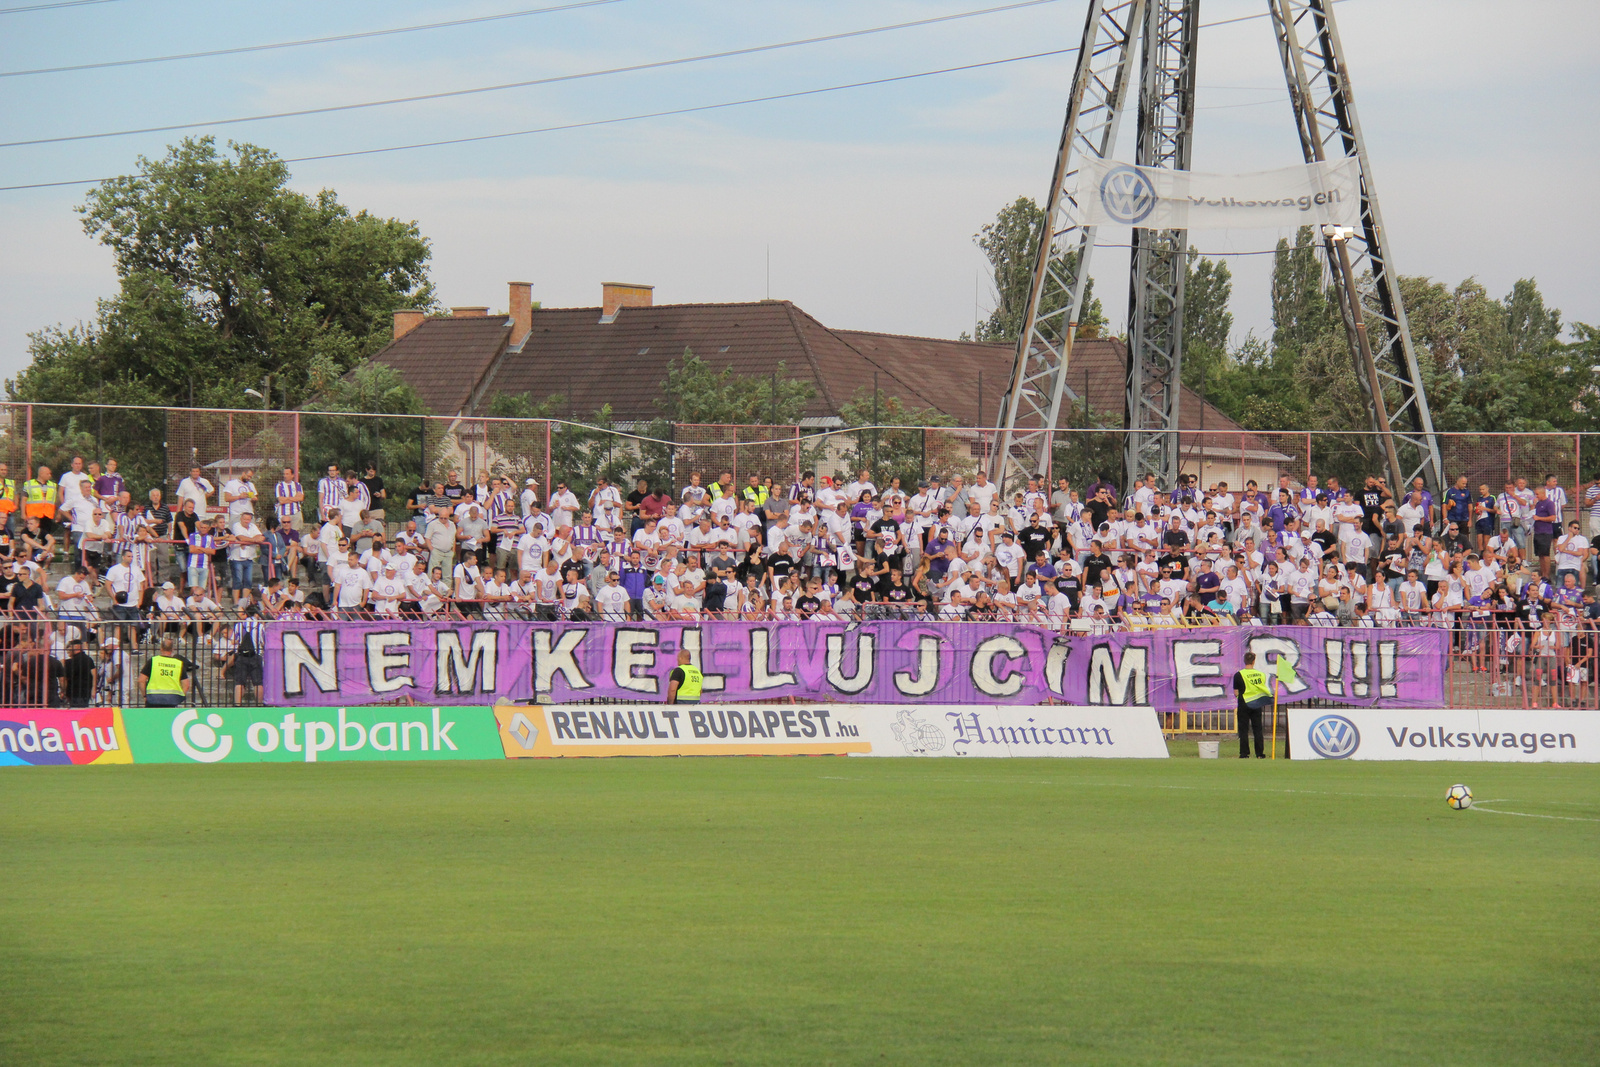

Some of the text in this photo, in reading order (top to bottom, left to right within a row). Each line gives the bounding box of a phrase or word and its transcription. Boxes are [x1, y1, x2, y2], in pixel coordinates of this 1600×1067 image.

[160, 668, 173, 676] 354
[280, 629, 499, 698] NEM
[531, 626, 798, 694] KELL
[553, 710, 682, 739] RENAULT
[944, 710, 1116, 756] Hunicorn
[1386, 726, 1577, 754] Volkswagen
